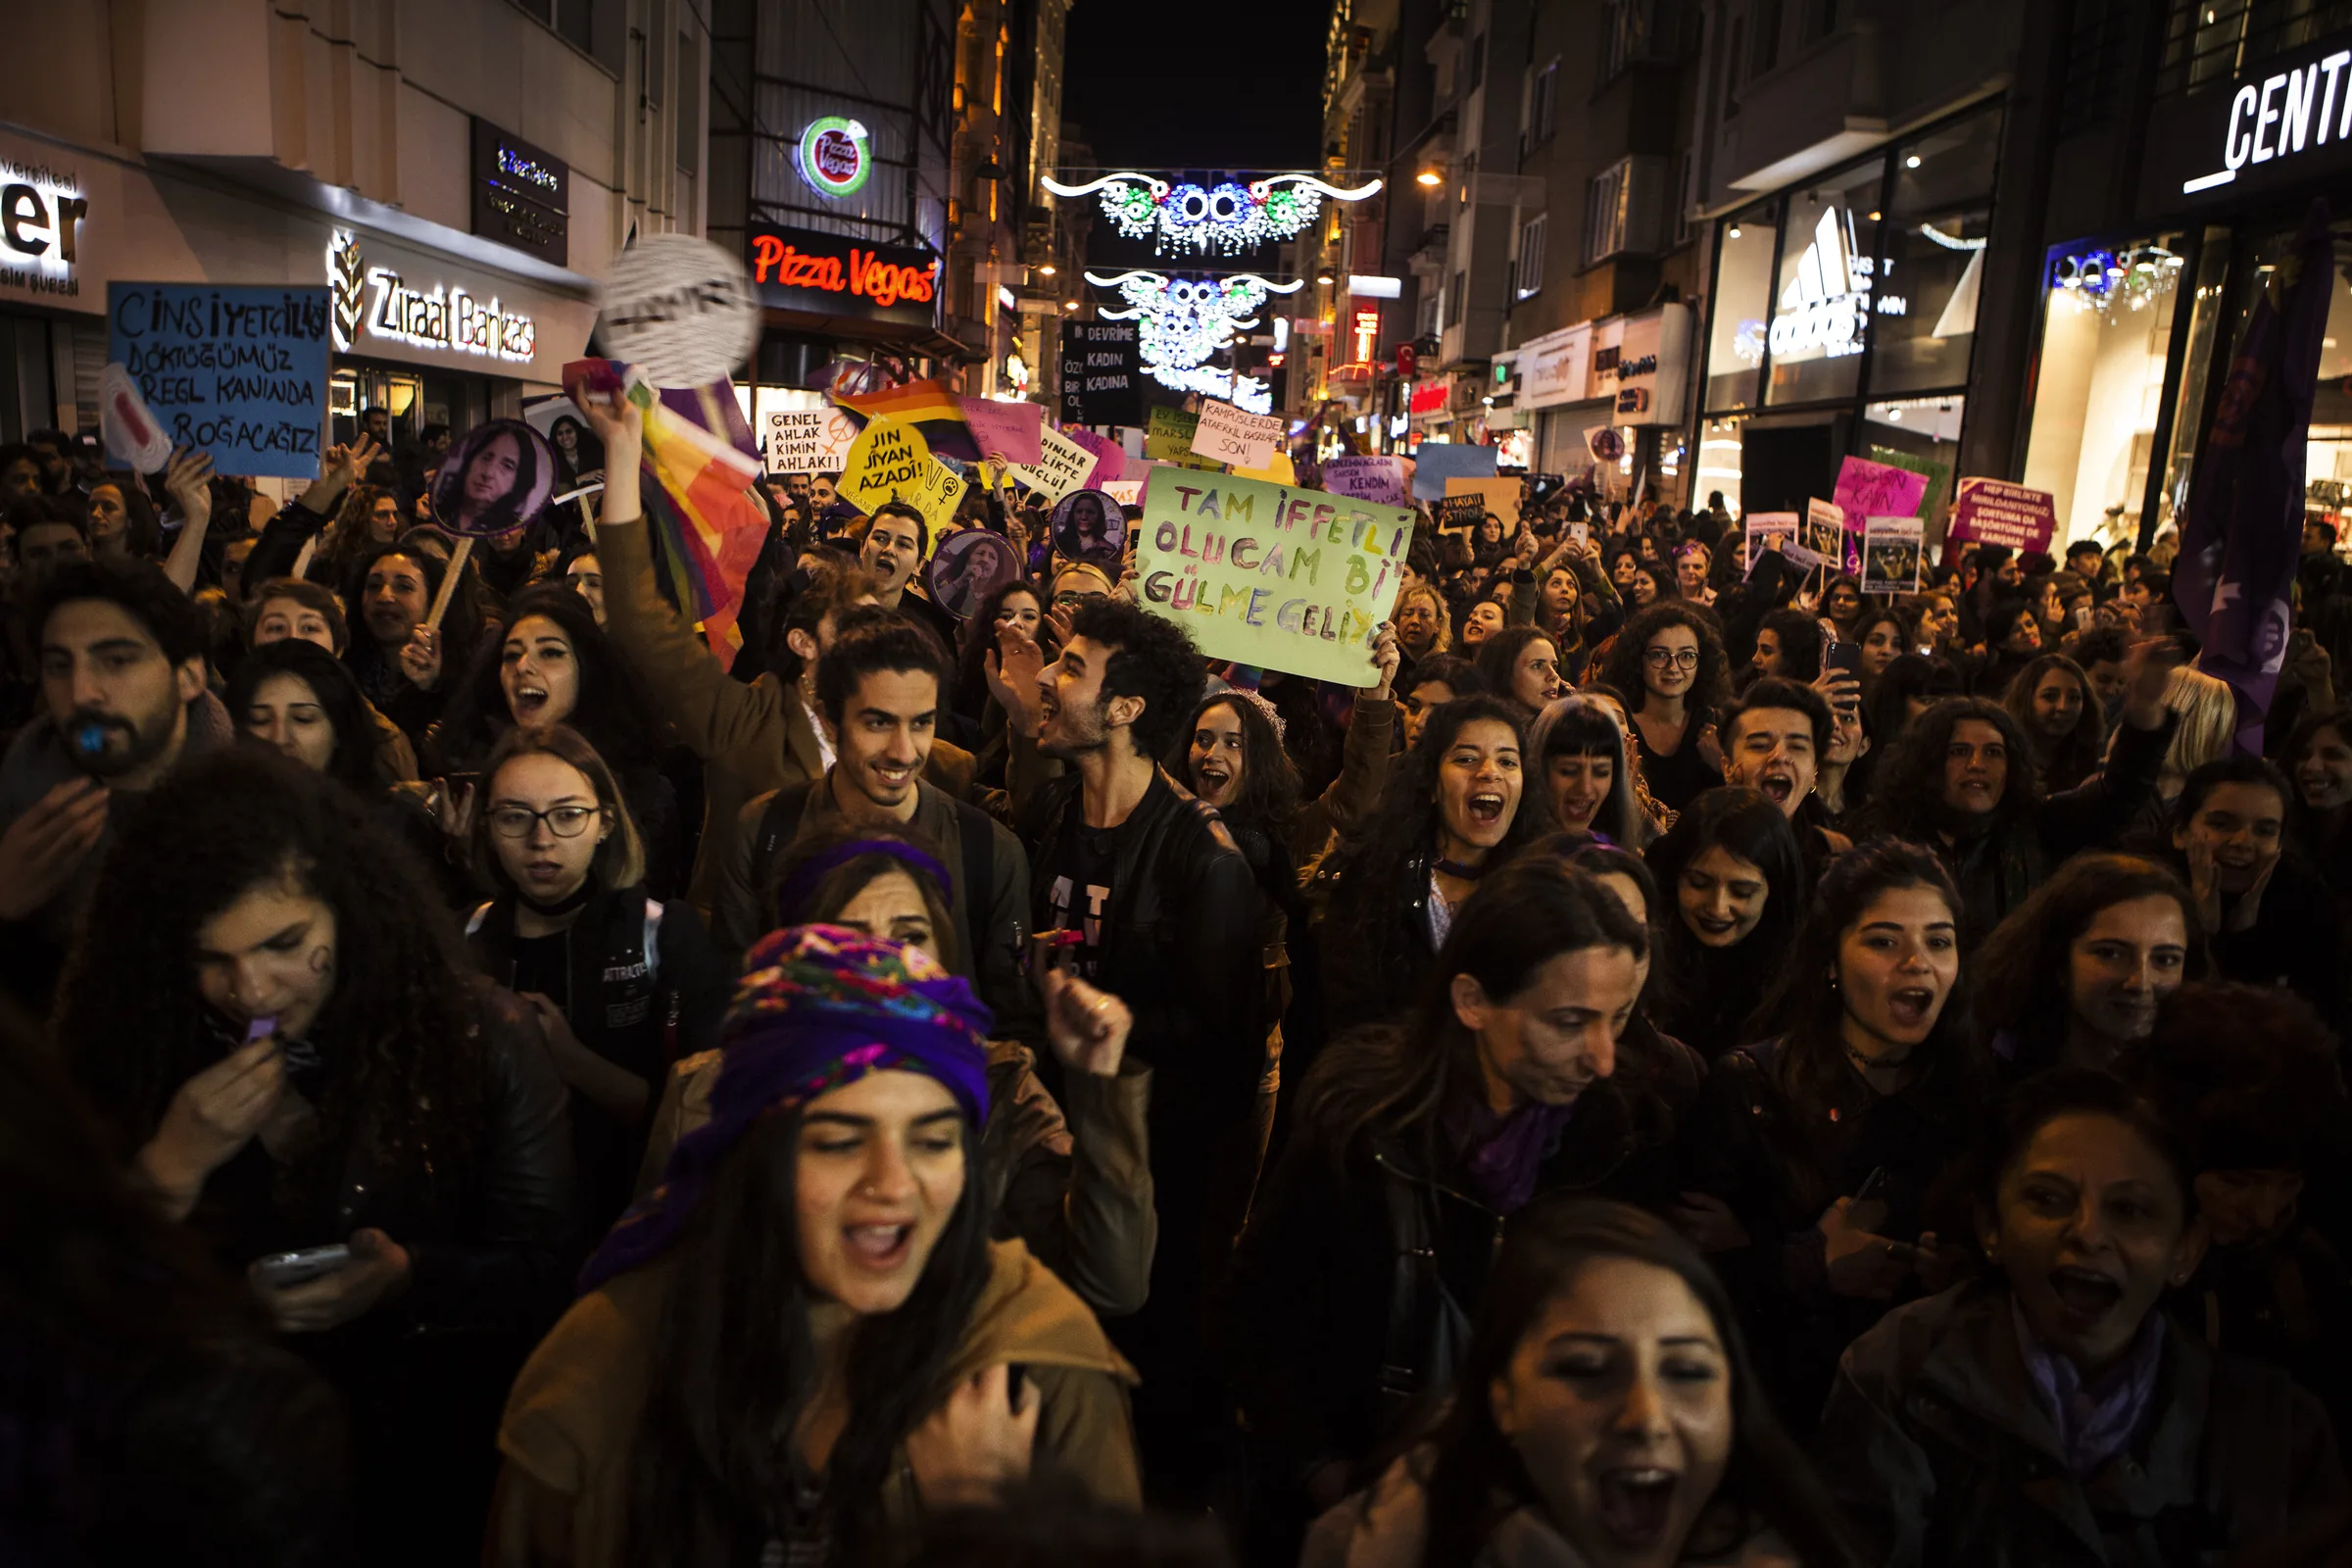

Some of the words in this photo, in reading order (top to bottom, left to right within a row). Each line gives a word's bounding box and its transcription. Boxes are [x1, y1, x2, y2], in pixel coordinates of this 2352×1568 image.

[820, 135, 856, 159] Pizza
[819, 148, 856, 174] Vegas
[753, 234, 847, 292] Pizza
[850, 248, 937, 307] Vegas
[368, 268, 450, 348] Ziraat
[451, 287, 536, 363] Bankası
[1088, 323, 1134, 341] DEVRİME
[126, 341, 293, 376] DÖKTÜĞÜMÜZ
[1087, 353, 1123, 367] KADIN
[139, 373, 205, 406] REGL
[217, 375, 315, 407] KANINDA
[1086, 375, 1129, 391] KADINA
[771, 414, 822, 426] GENEL
[1200, 417, 1241, 439] ATAERKİL
[1205, 403, 1281, 431] KAMPÜSLERDE
[775, 426, 821, 441] AHLAK
[870, 428, 901, 449] JIN
[776, 441, 816, 455] KİMİN
[1218, 438, 1250, 456] SON!
[1041, 452, 1079, 480] LİKTE
[1349, 474, 1390, 490] KENDİM
[846, 488, 875, 515] VEGANFE
[1175, 486, 1254, 523] TAM
[1274, 489, 1409, 558] İFFETLİ
[1155, 520, 1321, 586] OLUCAM
